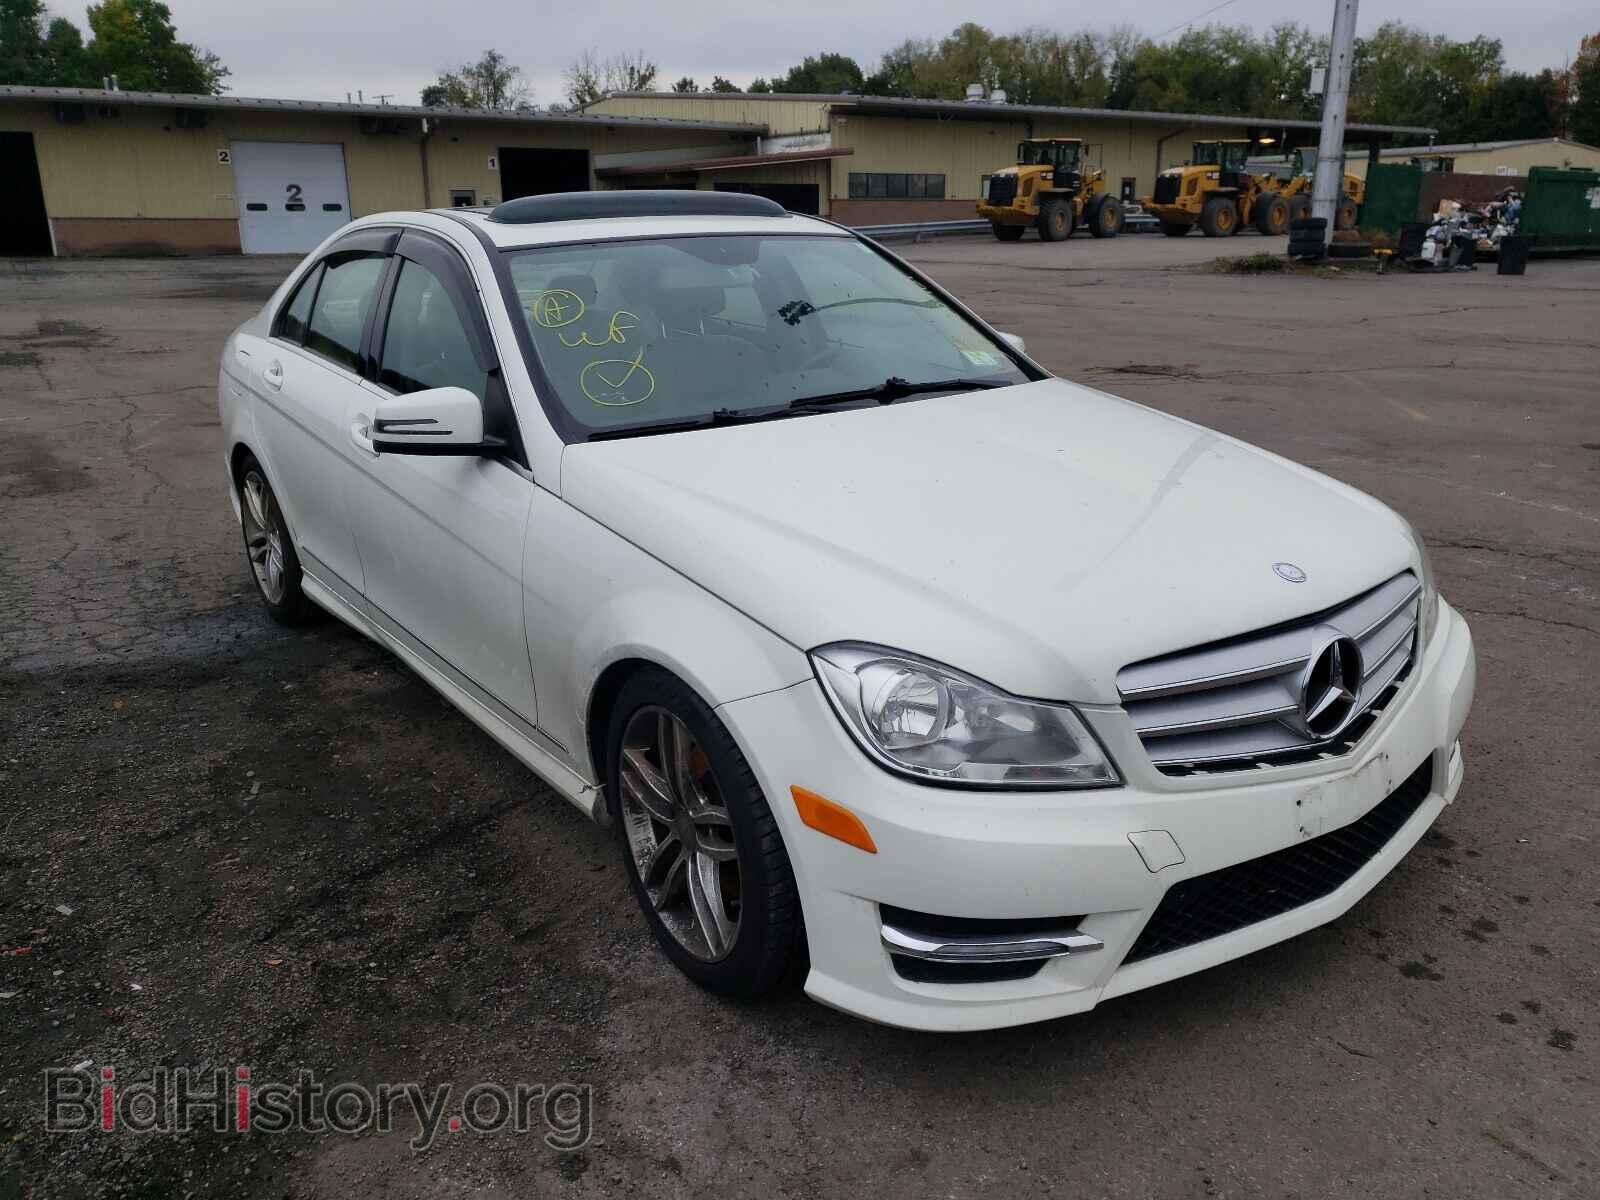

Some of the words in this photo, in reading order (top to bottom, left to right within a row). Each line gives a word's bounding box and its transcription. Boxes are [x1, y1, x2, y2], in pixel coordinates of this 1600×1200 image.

[219, 151, 230, 162] 2
[489, 158, 496, 168] 1
[286, 184, 304, 202] 2
